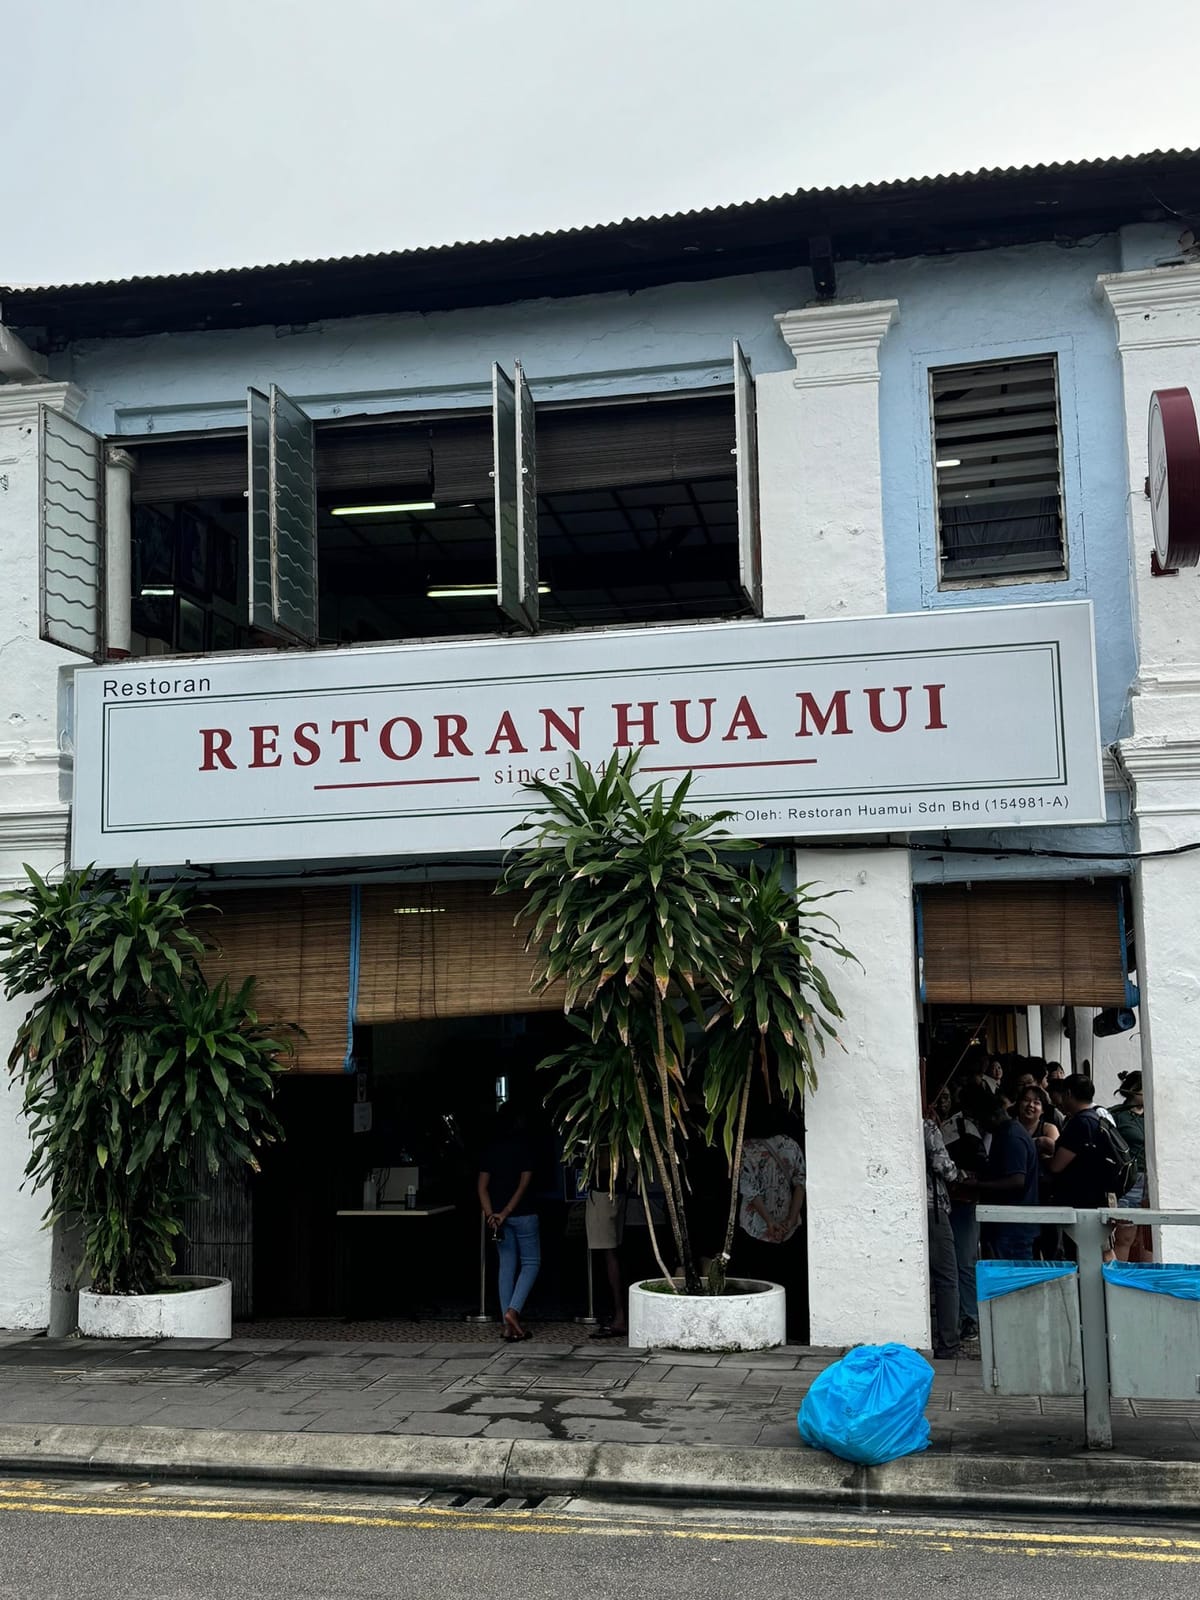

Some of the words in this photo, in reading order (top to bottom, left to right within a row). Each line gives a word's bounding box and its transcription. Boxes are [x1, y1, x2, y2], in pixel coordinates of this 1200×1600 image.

[103, 677, 211, 698] Restoran
[198, 706, 584, 772] RESTORAN
[612, 695, 767, 747] HUA
[795, 684, 948, 737] MUI
[745, 809, 782, 821] Oleh:
[788, 805, 851, 819] Restoran
[858, 802, 912, 816] Huamui
[918, 801, 946, 813] Sdn
[952, 798, 980, 812] Bhd
[984, 795, 1070, 813] (154981-A)
